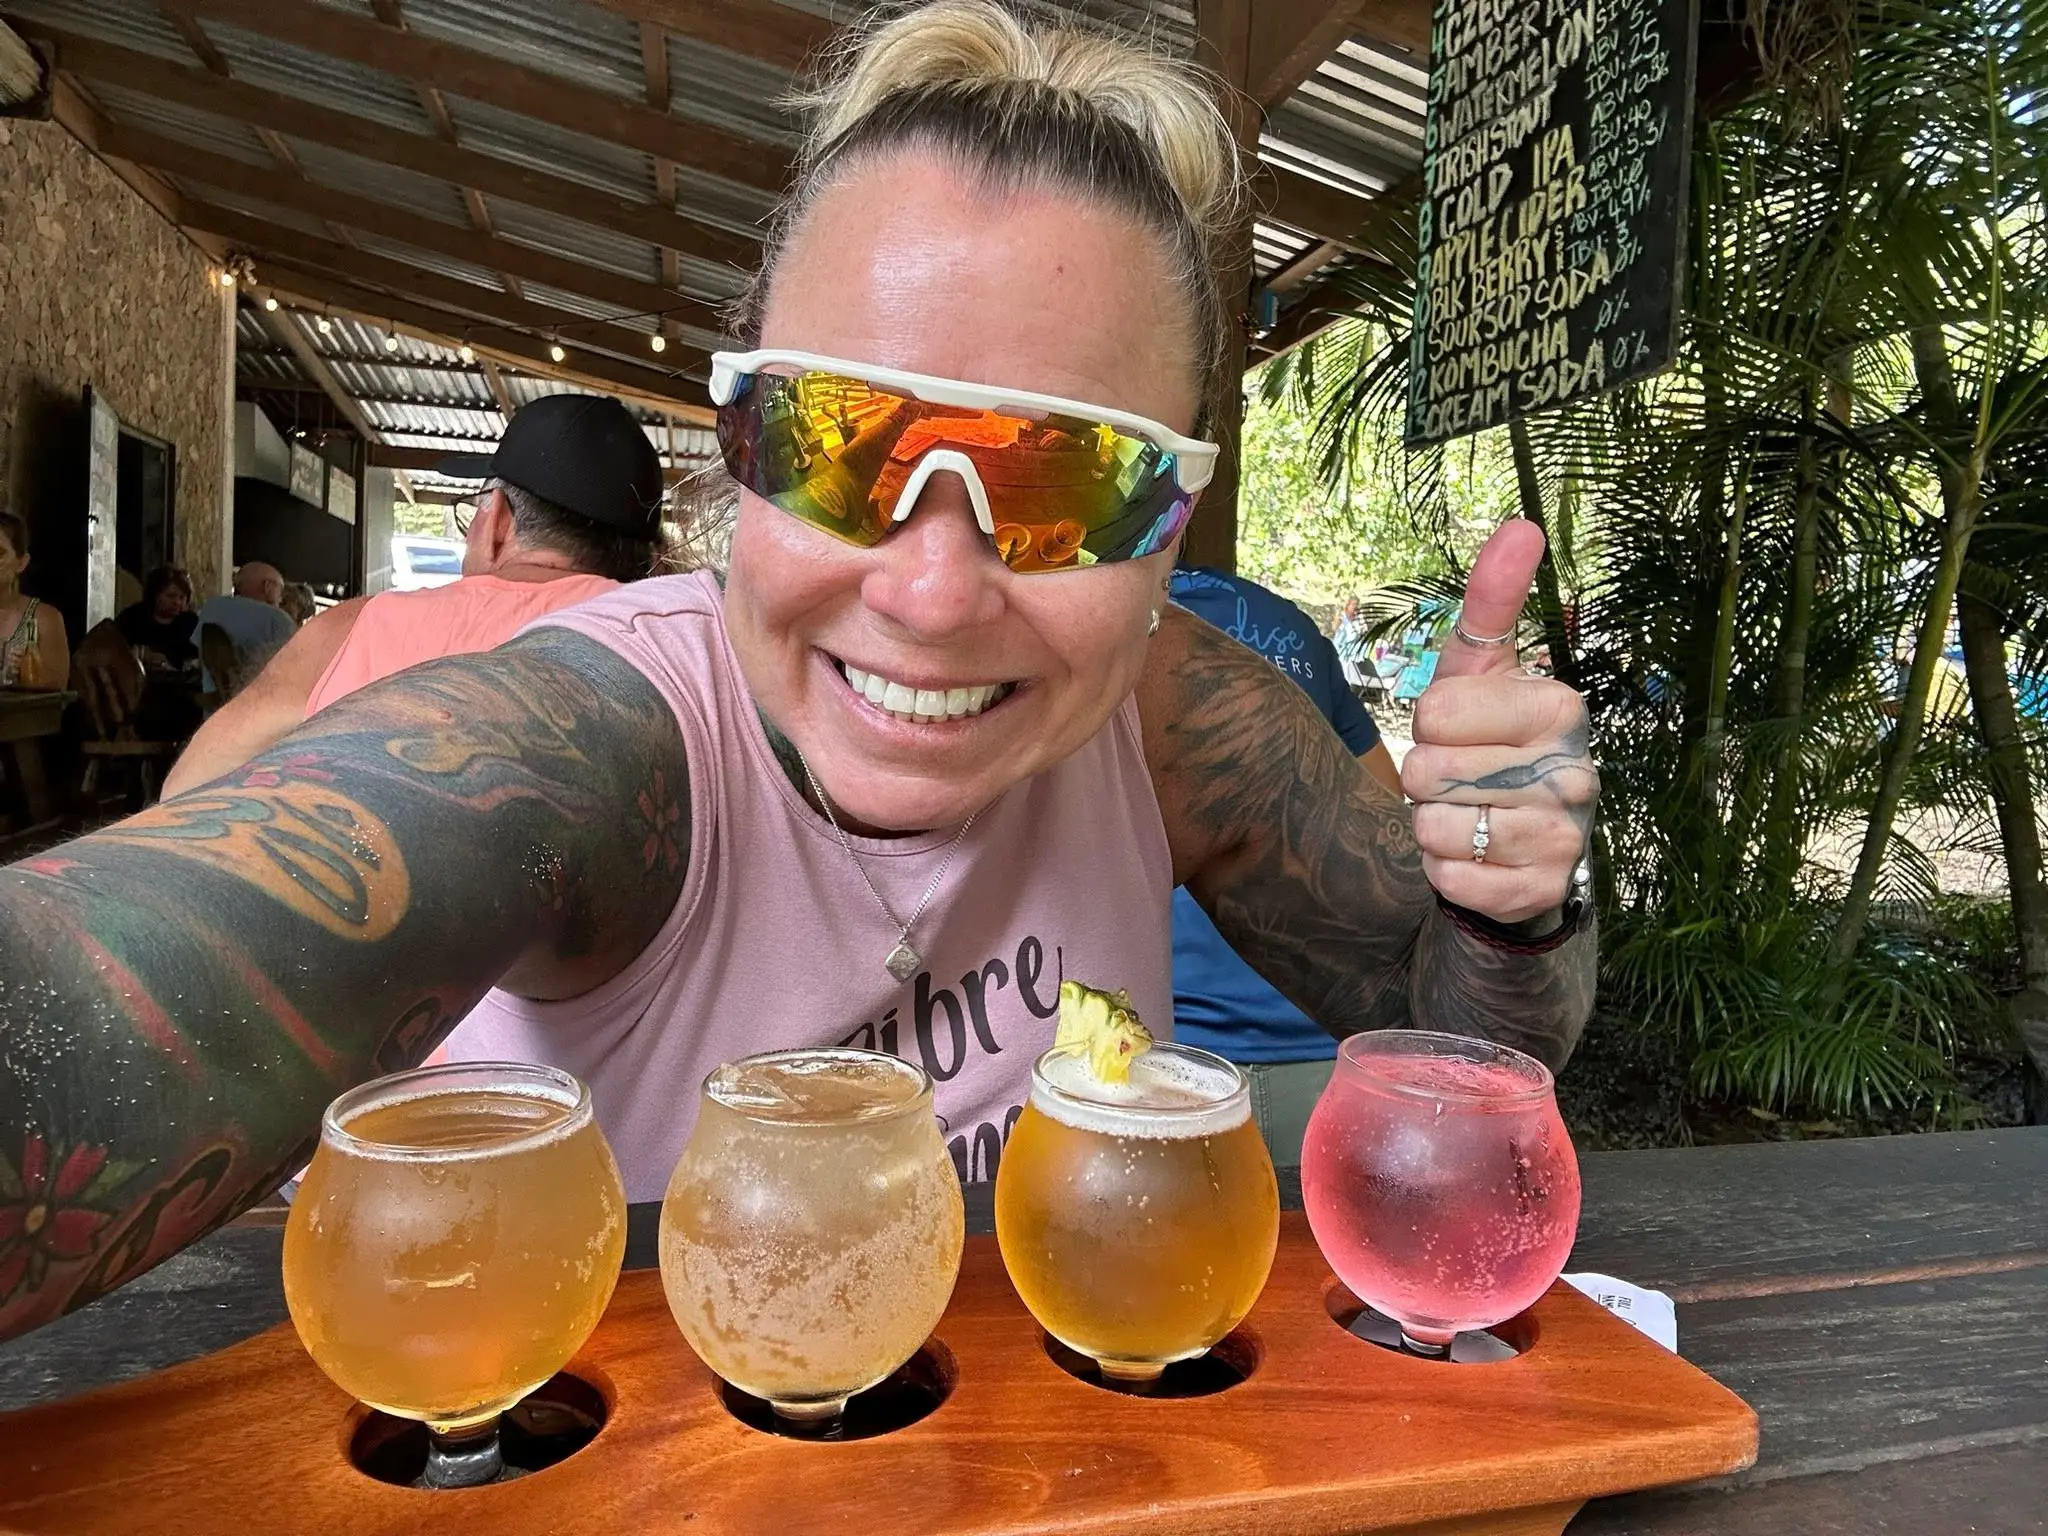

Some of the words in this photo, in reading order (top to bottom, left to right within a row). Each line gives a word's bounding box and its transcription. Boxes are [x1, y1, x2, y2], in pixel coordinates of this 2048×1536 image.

[1425, 106, 1439, 150] 6
[1440, 0, 1595, 149] WATERMELON
[1442, 0, 1541, 104] AMBER
[1628, 17, 1660, 69] 25
[1418, 200, 1433, 252] 8
[1439, 162, 1513, 240] COLD
[1533, 123, 1575, 189] IPA
[1428, 283, 1532, 362] SOURSOP
[1534, 246, 1610, 321] SODA
[1430, 216, 1497, 290] APPLE
[1471, 228, 1550, 312] BERRY
[1424, 377, 1511, 439] CREAM
[1517, 337, 1606, 412] SODA
[1429, 316, 1569, 401] KOMBUCHA
[1264, 653, 1314, 680] ERS
[836, 935, 1063, 1082] ibre
